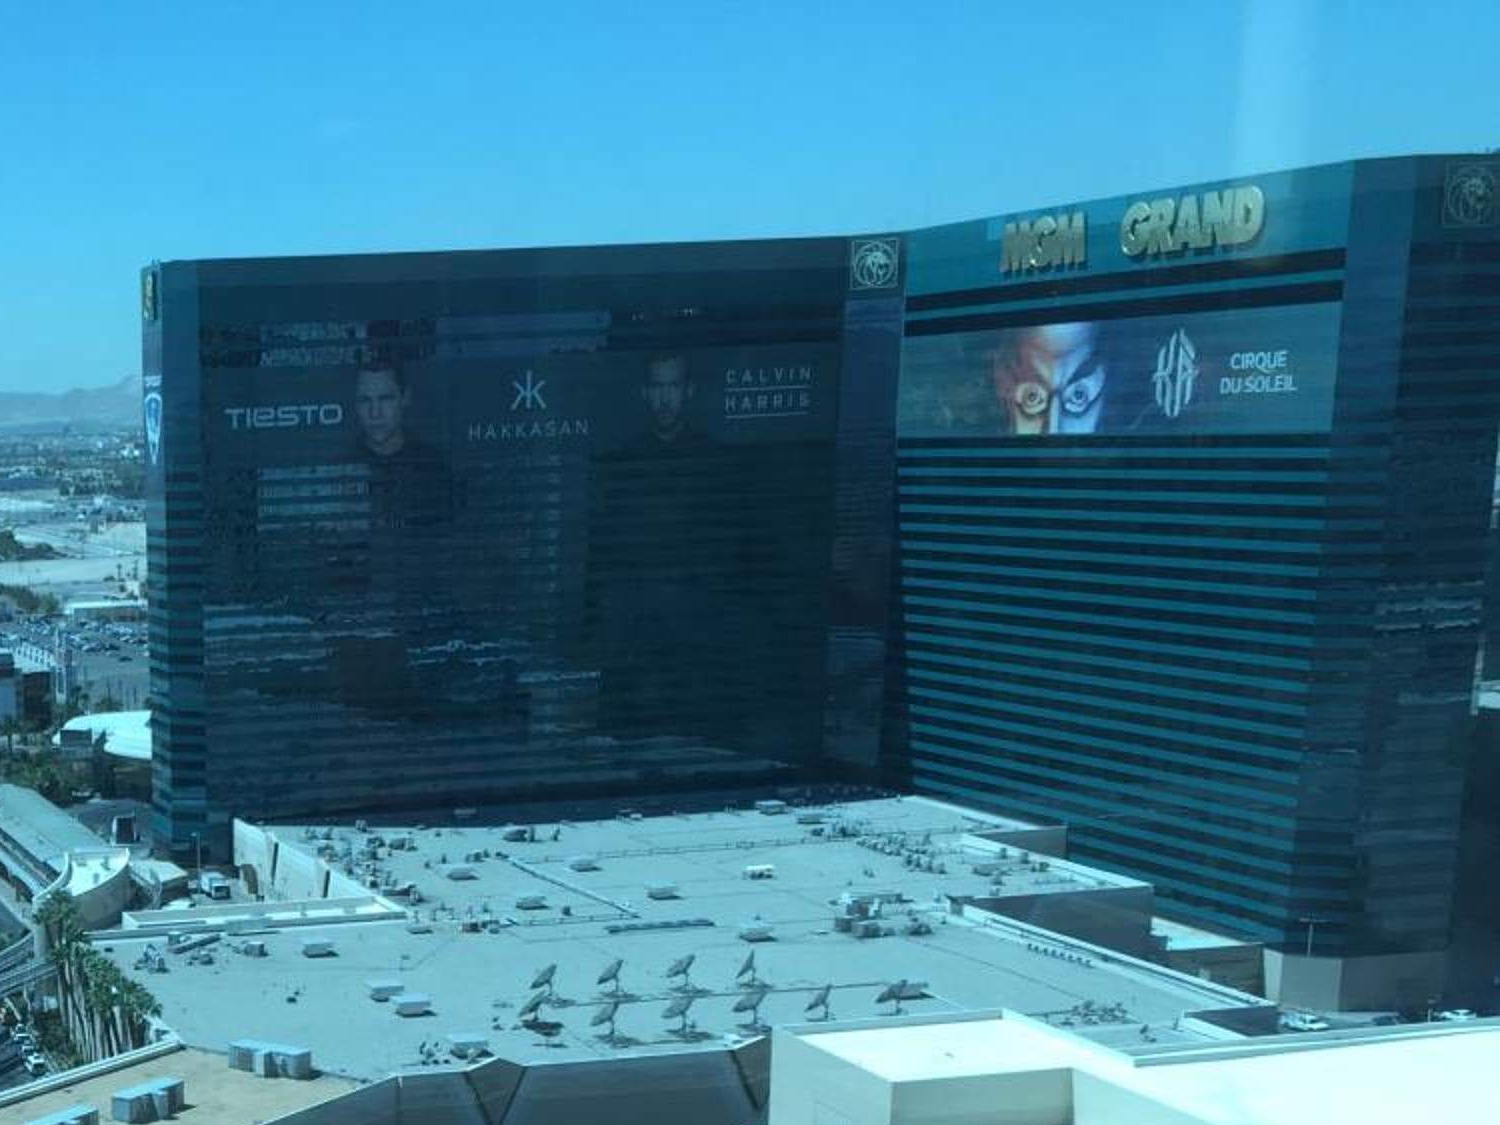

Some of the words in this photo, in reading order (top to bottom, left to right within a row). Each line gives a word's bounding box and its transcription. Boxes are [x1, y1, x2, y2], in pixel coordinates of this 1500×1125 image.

[1000, 211, 1088, 273] MGM
[1120, 184, 1265, 258] GRAND
[1230, 350, 1288, 373] CIRQUE
[725, 366, 811, 384] CALVIN
[1220, 377, 1241, 394] DU
[1243, 374, 1298, 393] SOLEIL
[468, 420, 590, 440] HAKKASAN
